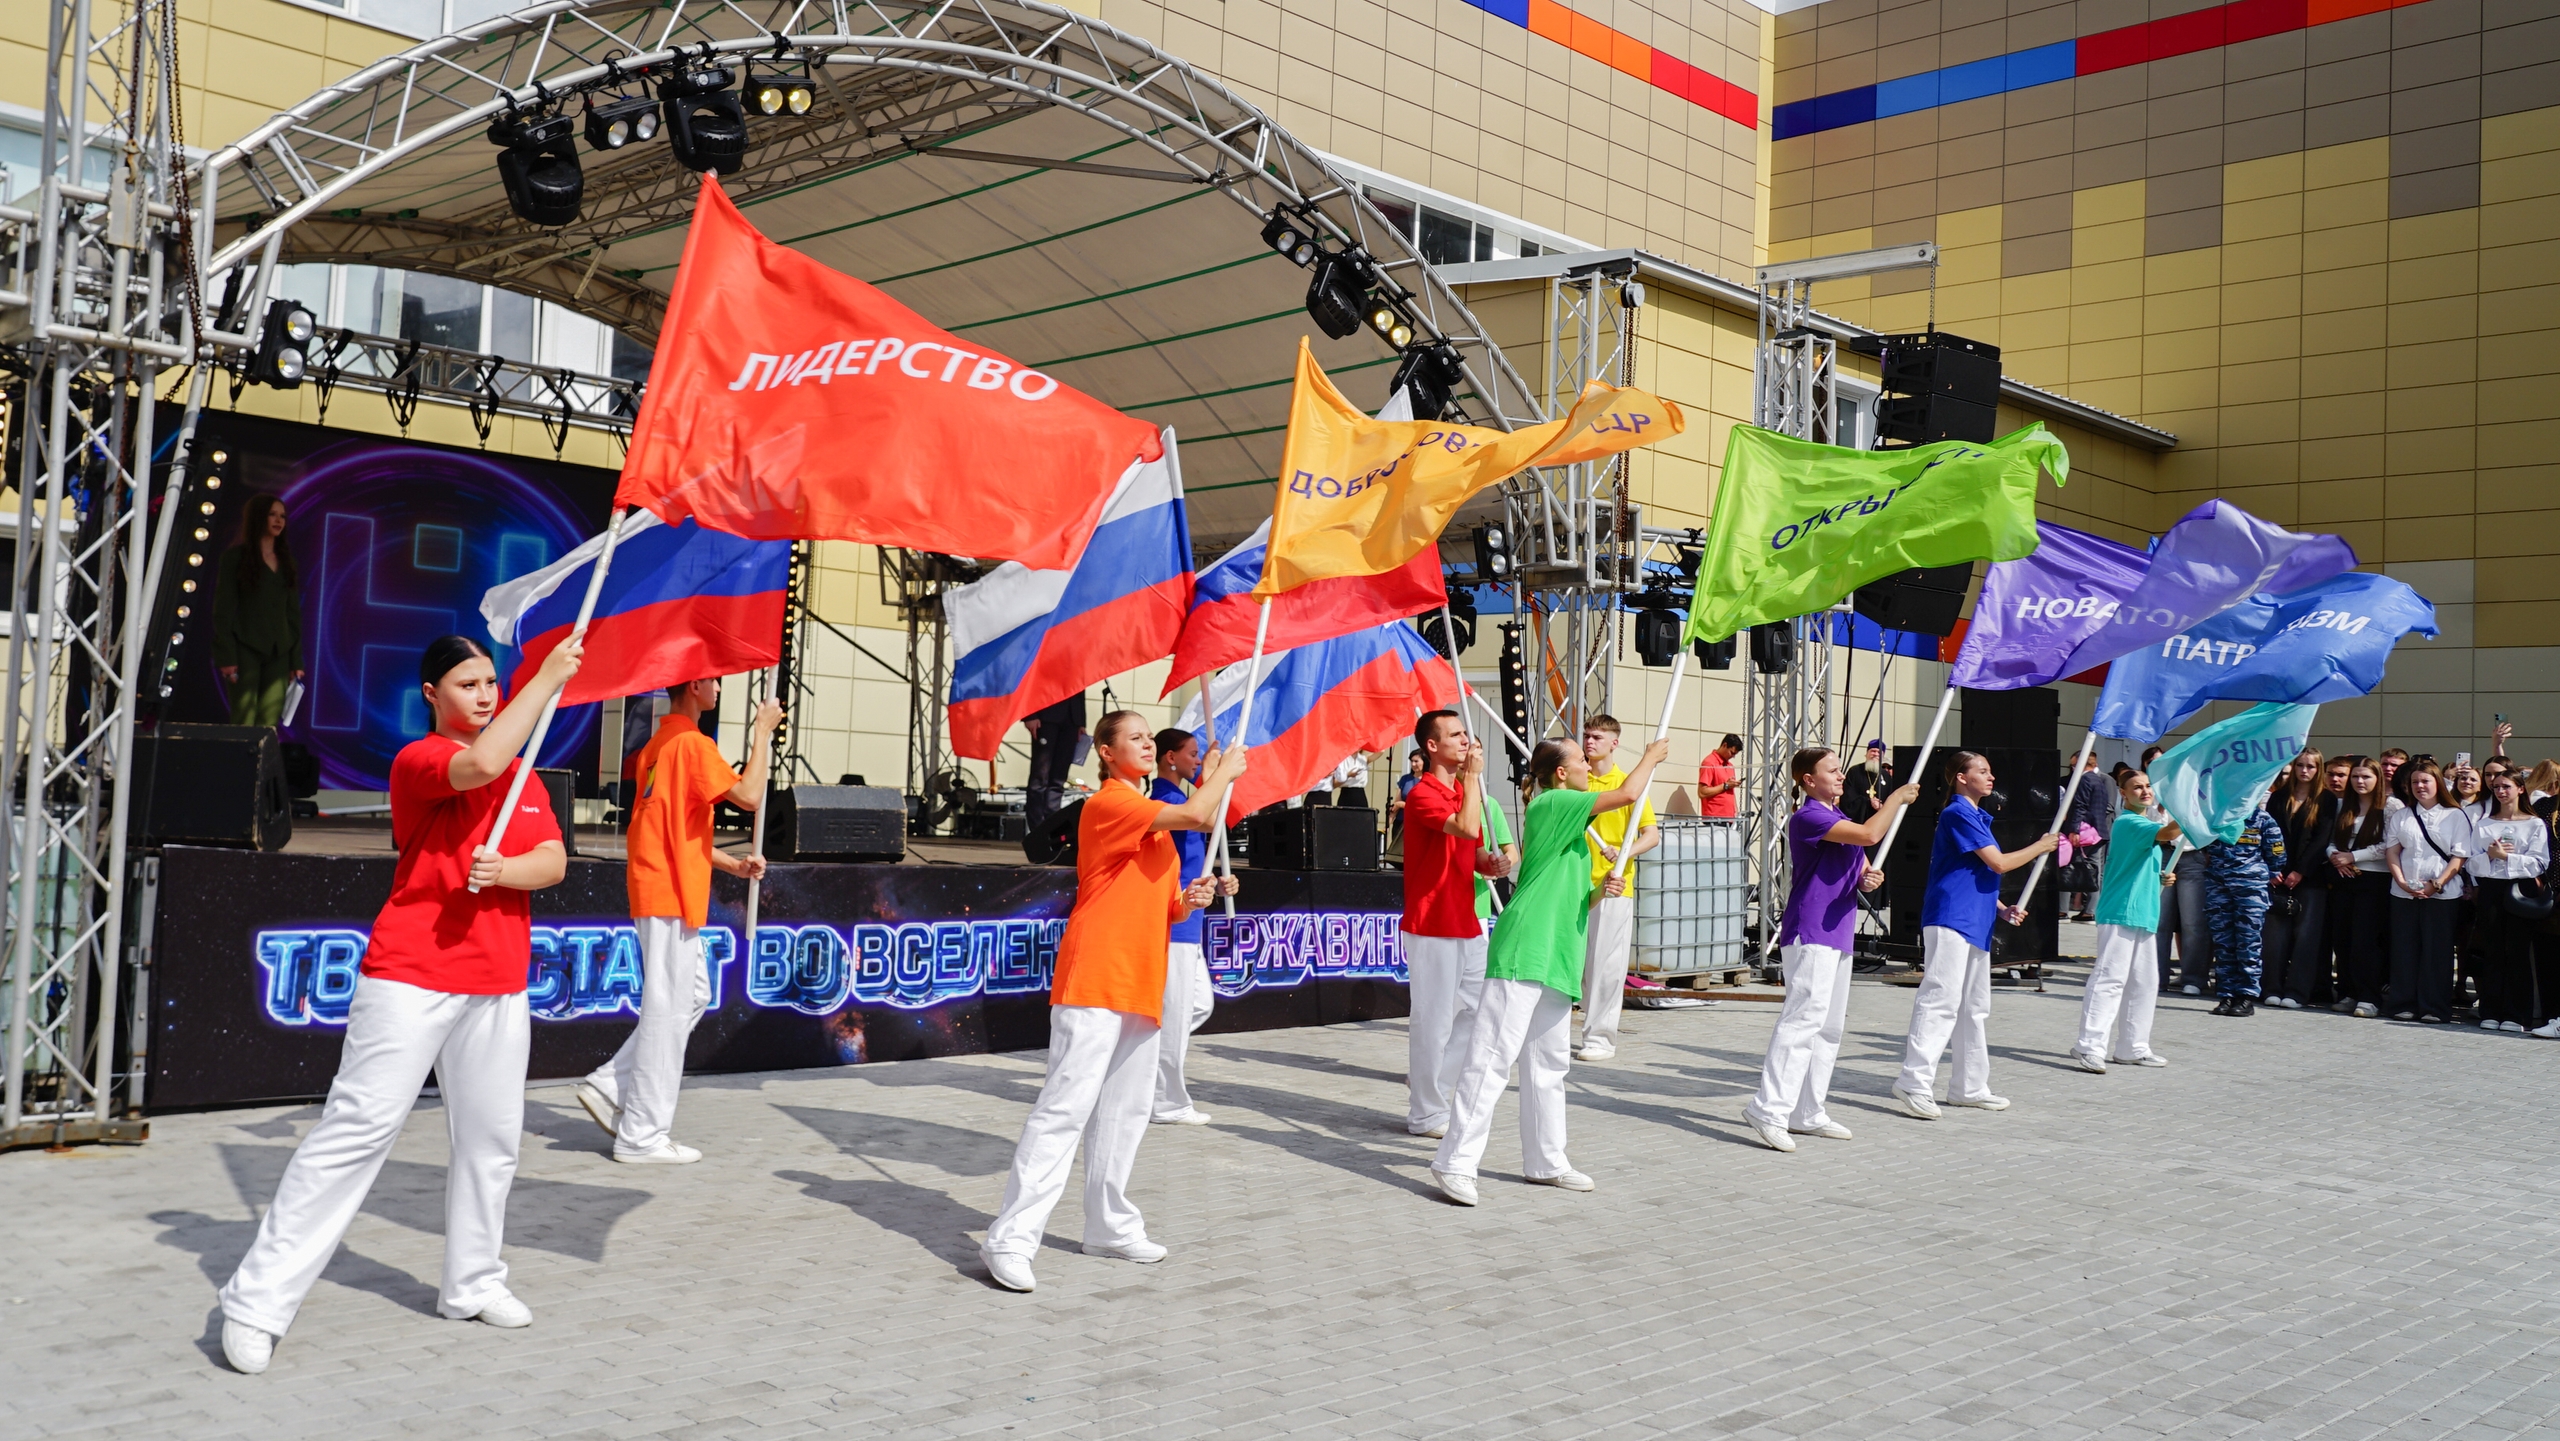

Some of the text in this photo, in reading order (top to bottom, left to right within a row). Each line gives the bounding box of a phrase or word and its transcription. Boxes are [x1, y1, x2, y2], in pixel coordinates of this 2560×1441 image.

[728, 337, 1058, 401] ЛИДЕРСТВО
[2162, 610, 2371, 666] ПАТРИЗМ
[257, 913, 1410, 1025] ТВ СТАТ ВО ВСЕЛЕН ЕРЖАВИН
